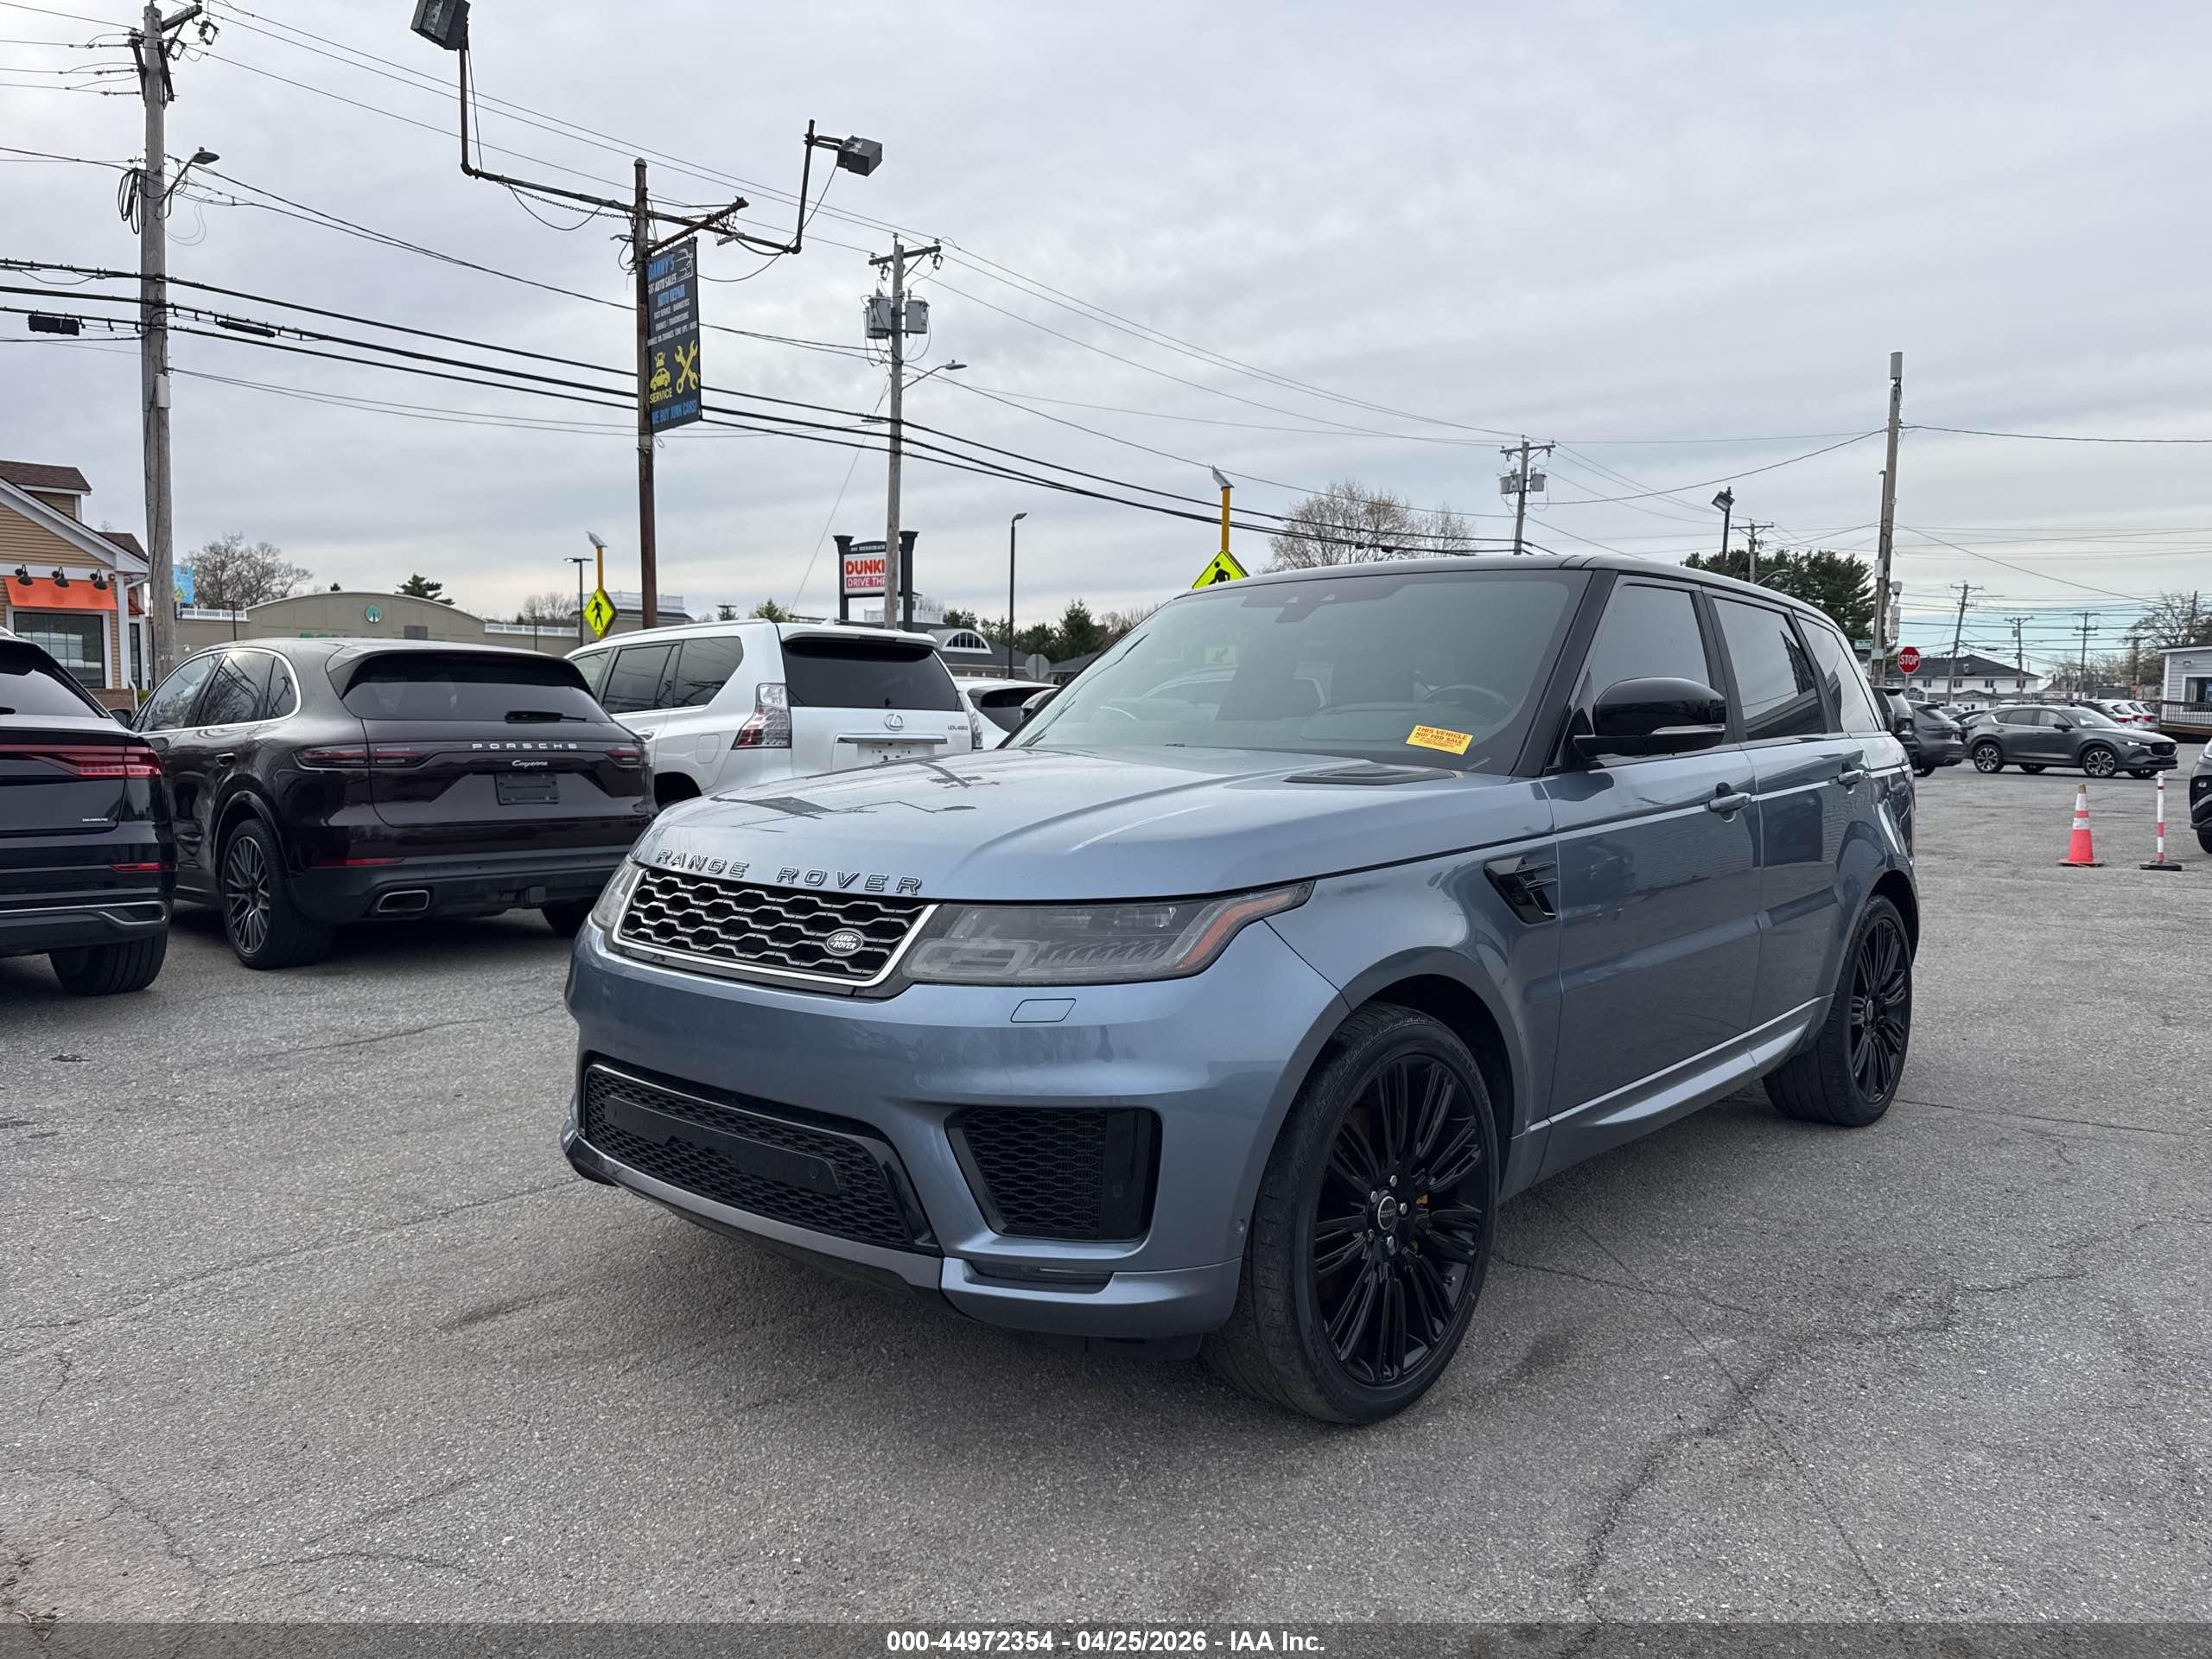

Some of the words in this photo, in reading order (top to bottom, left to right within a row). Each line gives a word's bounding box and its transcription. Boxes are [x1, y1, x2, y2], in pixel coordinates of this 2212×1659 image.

[655, 278, 665, 292] AUTO
[665, 272, 677, 287] SALES
[650, 387, 672, 404] SERVICE
[846, 558, 885, 575] DUNKI
[848, 577, 869, 587] DRIVE
[1900, 654, 1918, 664] STOP
[1436, 729, 1467, 741] VEHICLE
[512, 760, 549, 769] Cayenne
[656, 849, 749, 879] RANGE
[775, 866, 923, 896] ROVER
[833, 941, 856, 950] ROVER
